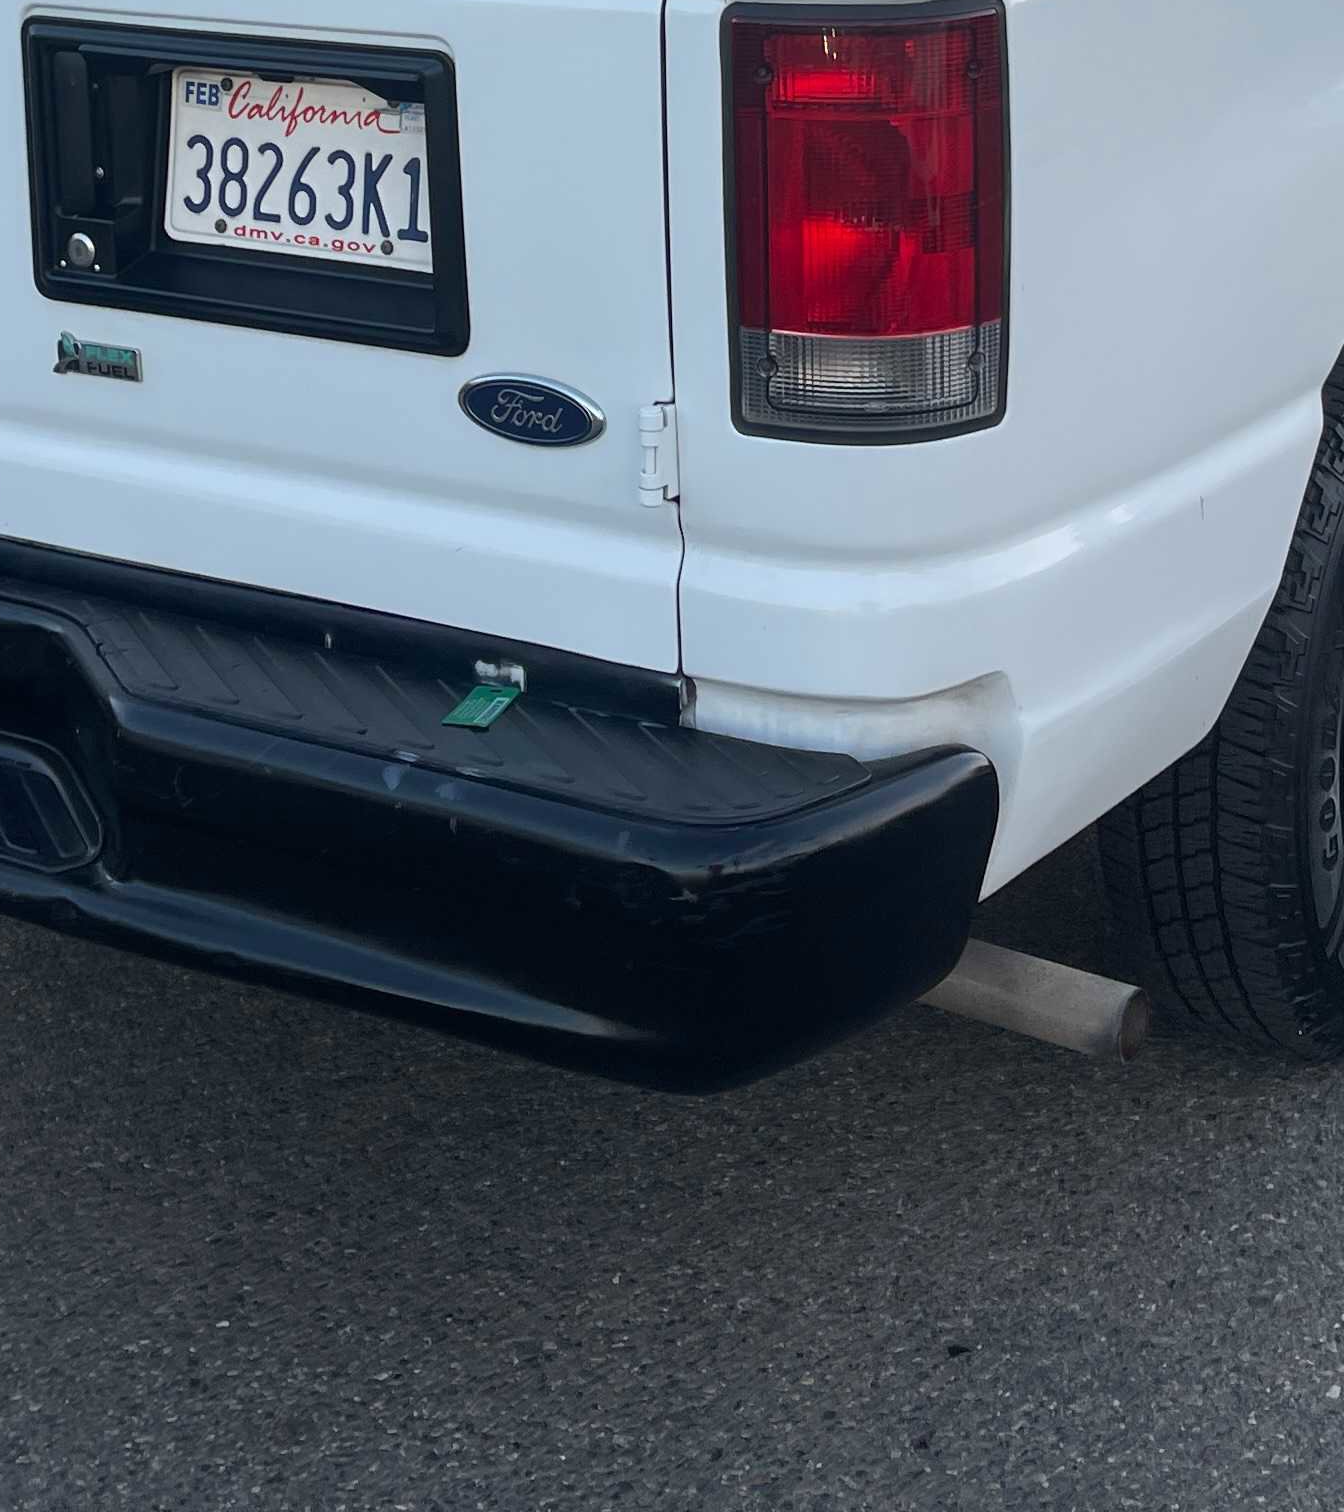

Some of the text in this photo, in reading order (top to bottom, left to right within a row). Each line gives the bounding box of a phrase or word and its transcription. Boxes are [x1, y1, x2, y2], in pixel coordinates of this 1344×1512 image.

[184, 80, 401, 137] FEB California
[183, 134, 429, 243] 38263K1
[233, 225, 376, 252] dmv.ca.gov
[87, 360, 136, 381] FUEL
[490, 388, 563, 433] Ford
